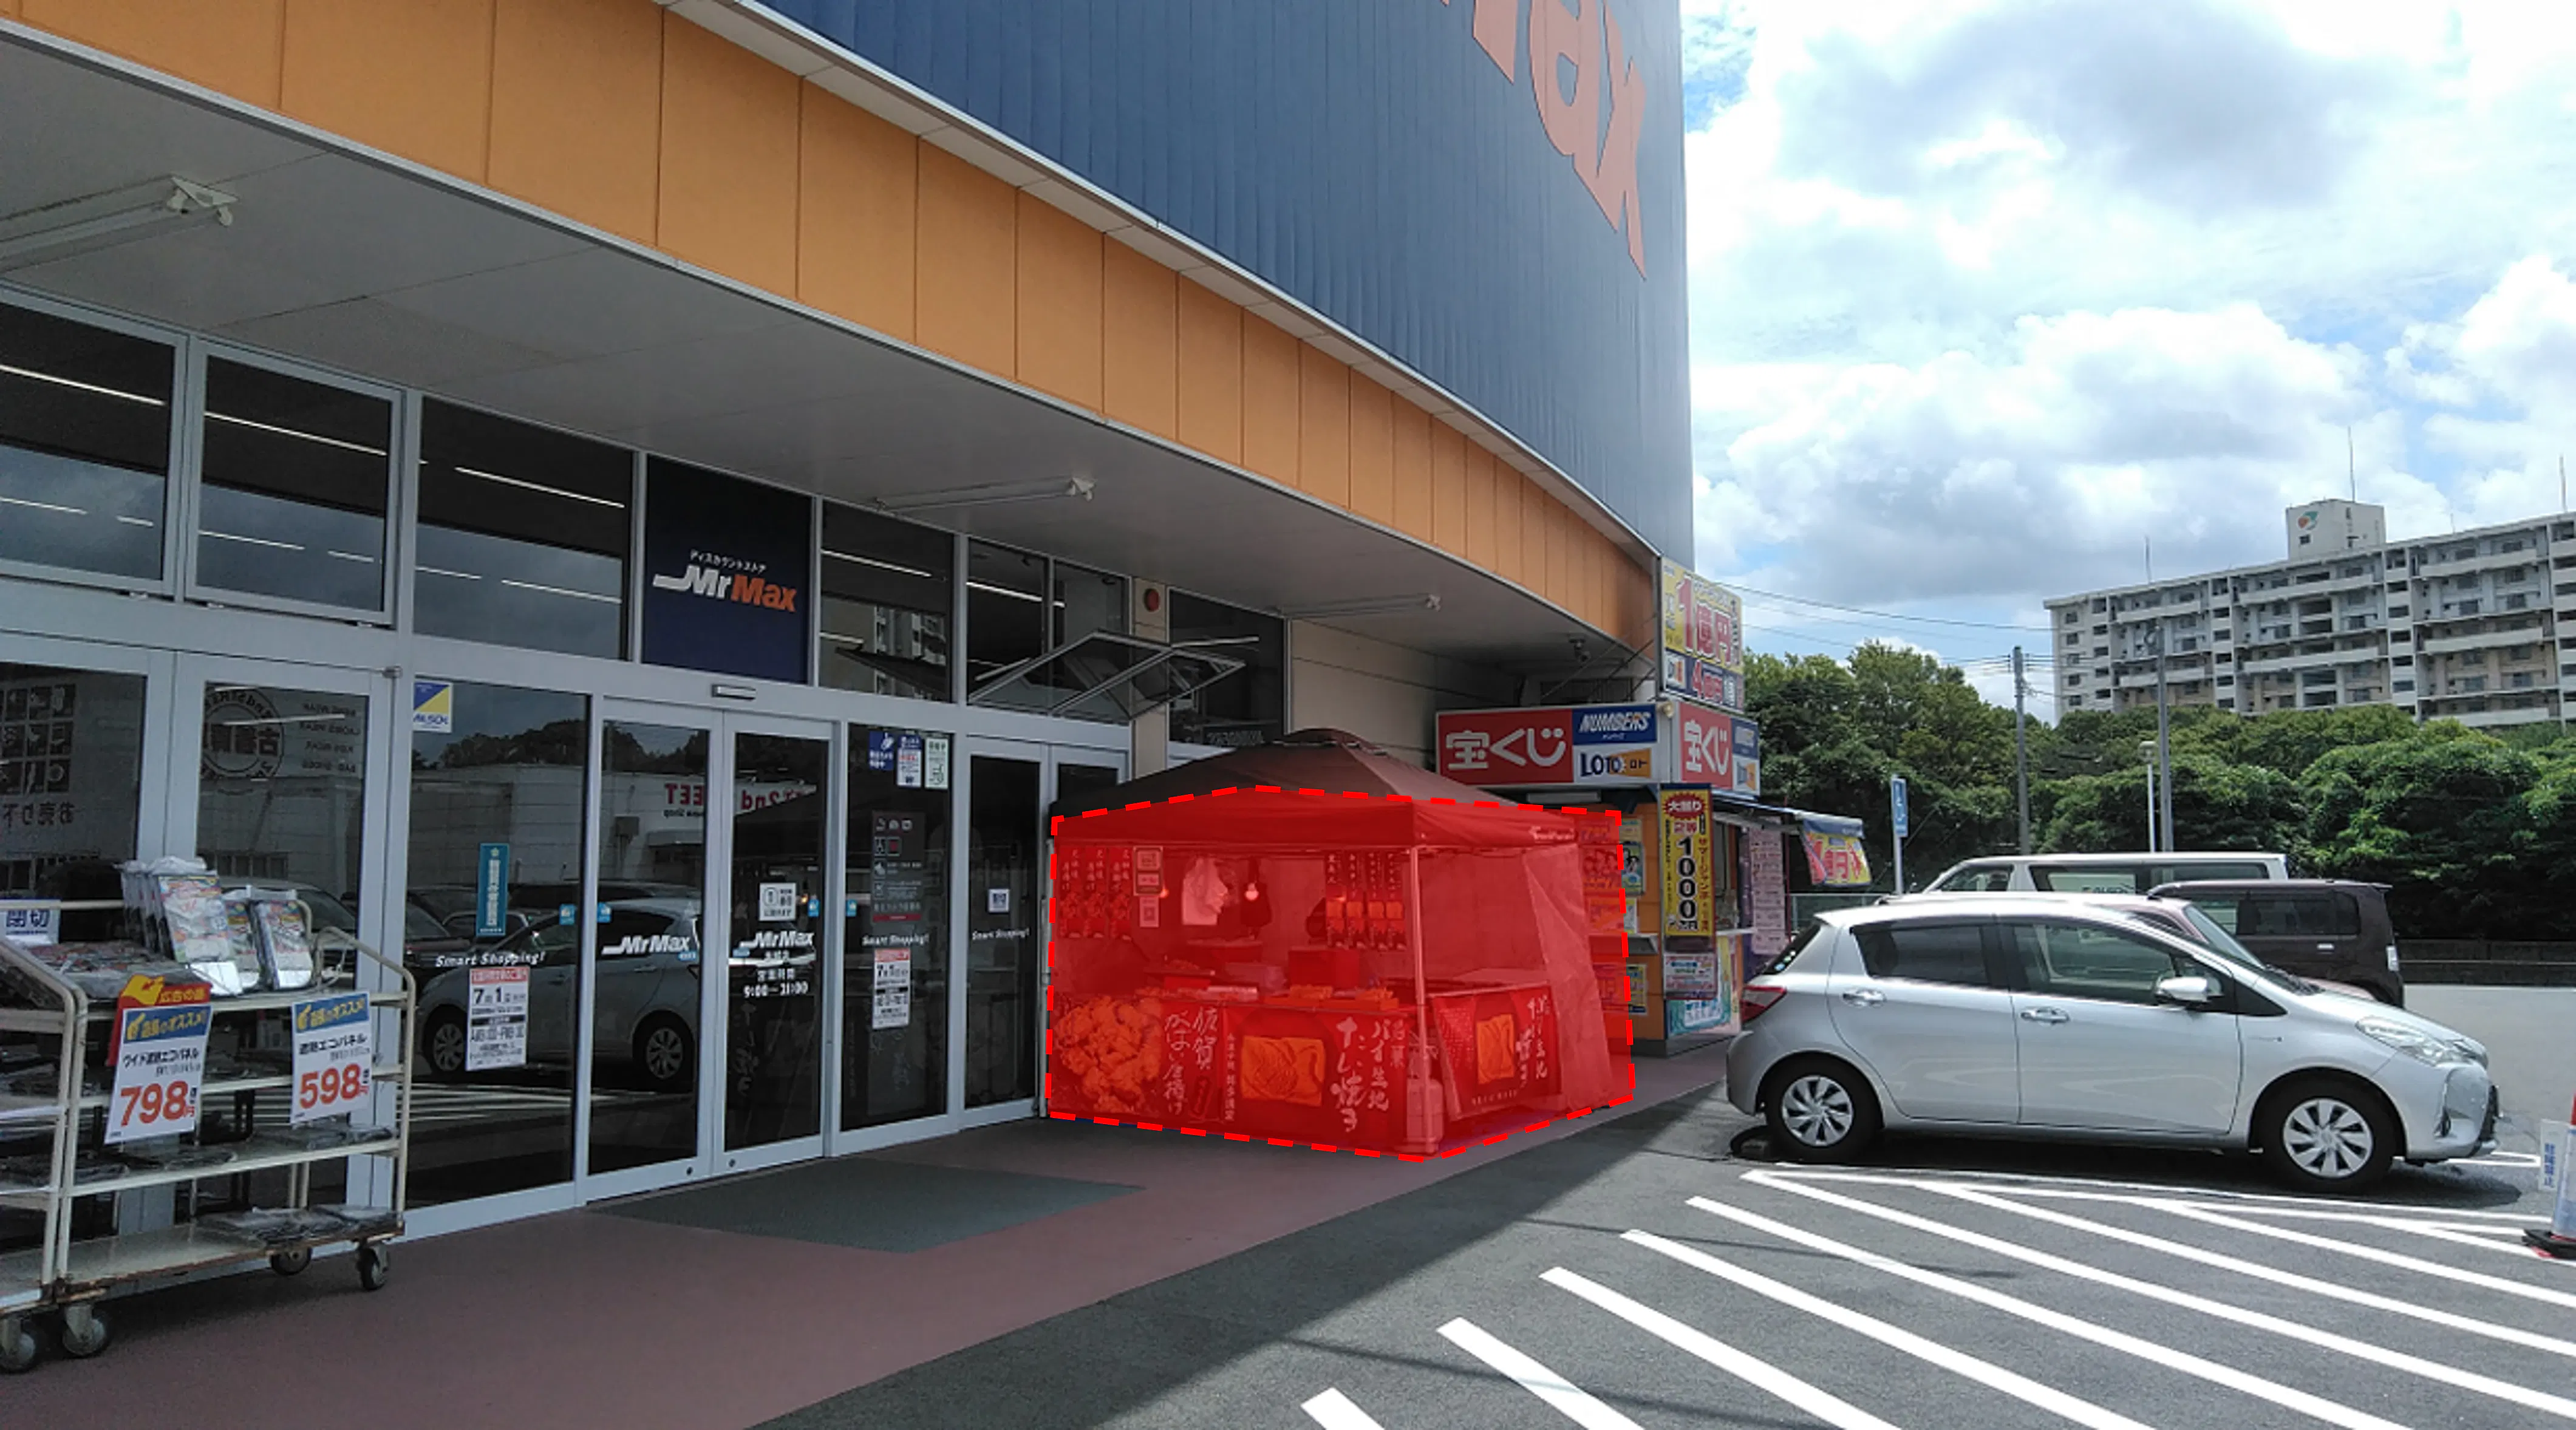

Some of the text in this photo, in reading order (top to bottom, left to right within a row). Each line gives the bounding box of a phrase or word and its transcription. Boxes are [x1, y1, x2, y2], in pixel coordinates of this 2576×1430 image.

[653, 563, 797, 613] MrMax
[1578, 711, 1652, 734] NUMBERS
[1445, 727, 1566, 770] 宝くじ
[1683, 719, 1729, 775] 宝くじ
[1580, 752, 1621, 777] LOTO
[601, 934, 691, 956] MrMax
[738, 930, 816, 949] MrMax
[435, 950, 546, 969] Smart Shopping!
[299, 1062, 361, 1110] 598
[121, 1080, 189, 1127] 798
